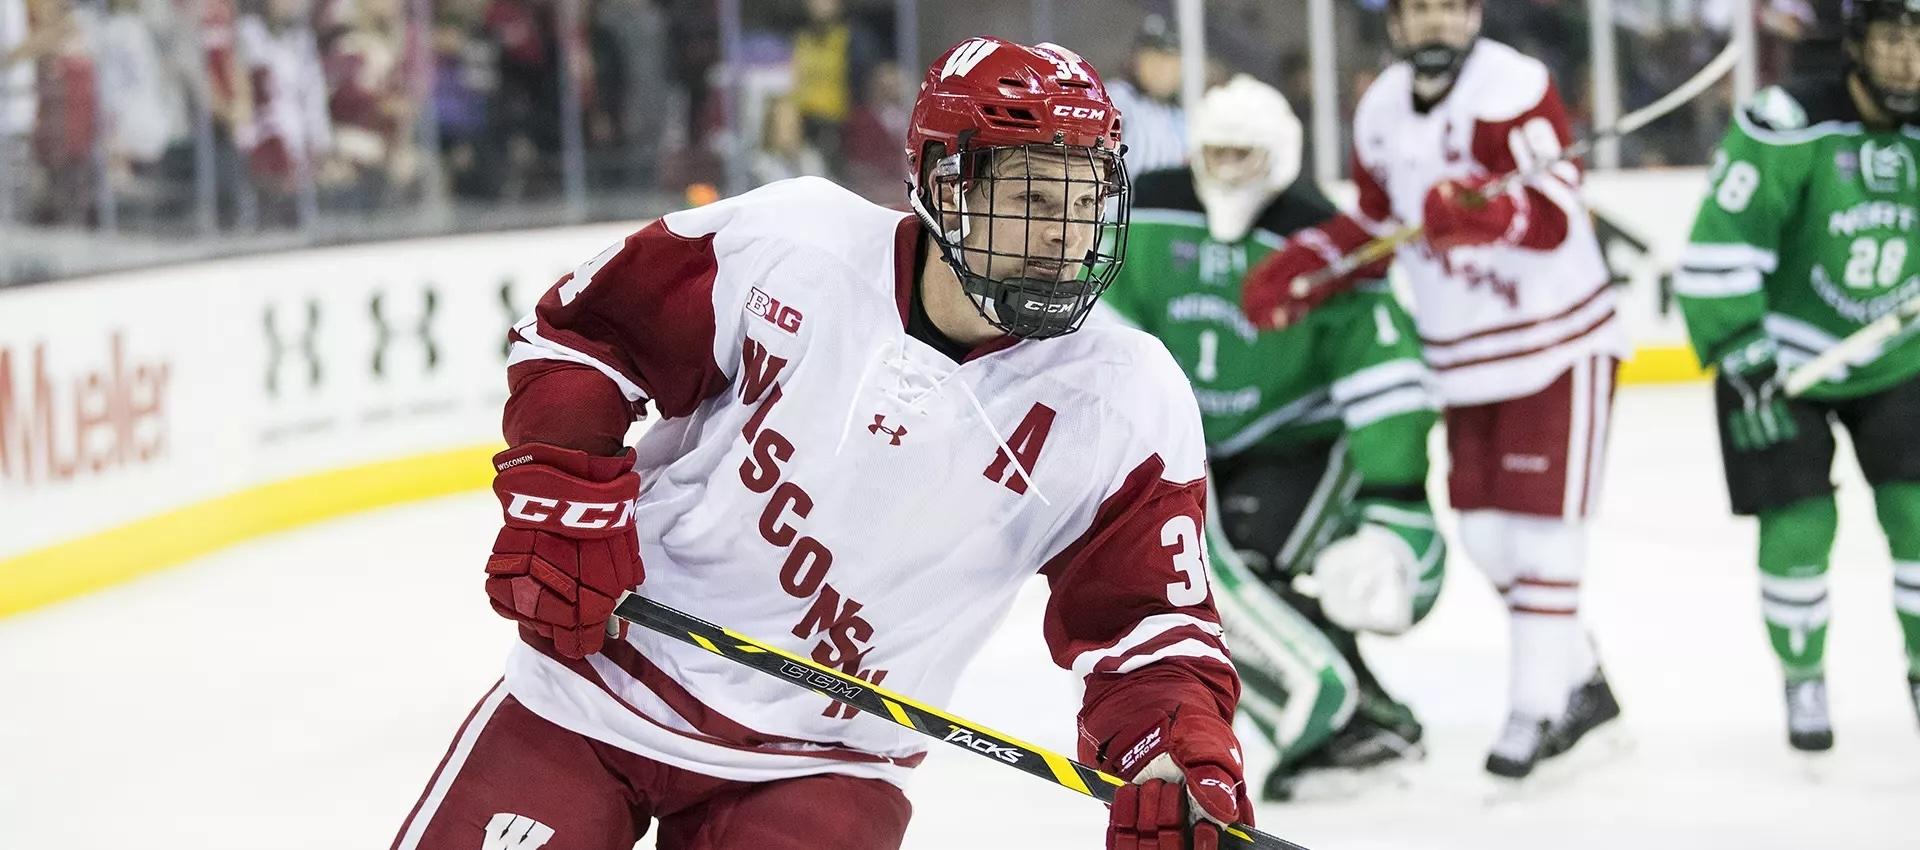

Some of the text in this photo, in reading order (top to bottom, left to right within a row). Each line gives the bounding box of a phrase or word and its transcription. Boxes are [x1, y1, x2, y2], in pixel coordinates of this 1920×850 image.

[941, 40, 1001, 83] W
[1052, 104, 1106, 121] CCM
[1024, 299, 1075, 314] CCM
[498, 454, 533, 471] WISCONSIN
[983, 401, 1056, 496] A
[1160, 515, 1209, 607] 3
[780, 659, 863, 699] CCM
[944, 725, 1023, 764] TACKS
[1121, 727, 1161, 766] CCM
[1134, 745, 1150, 762] PRO
